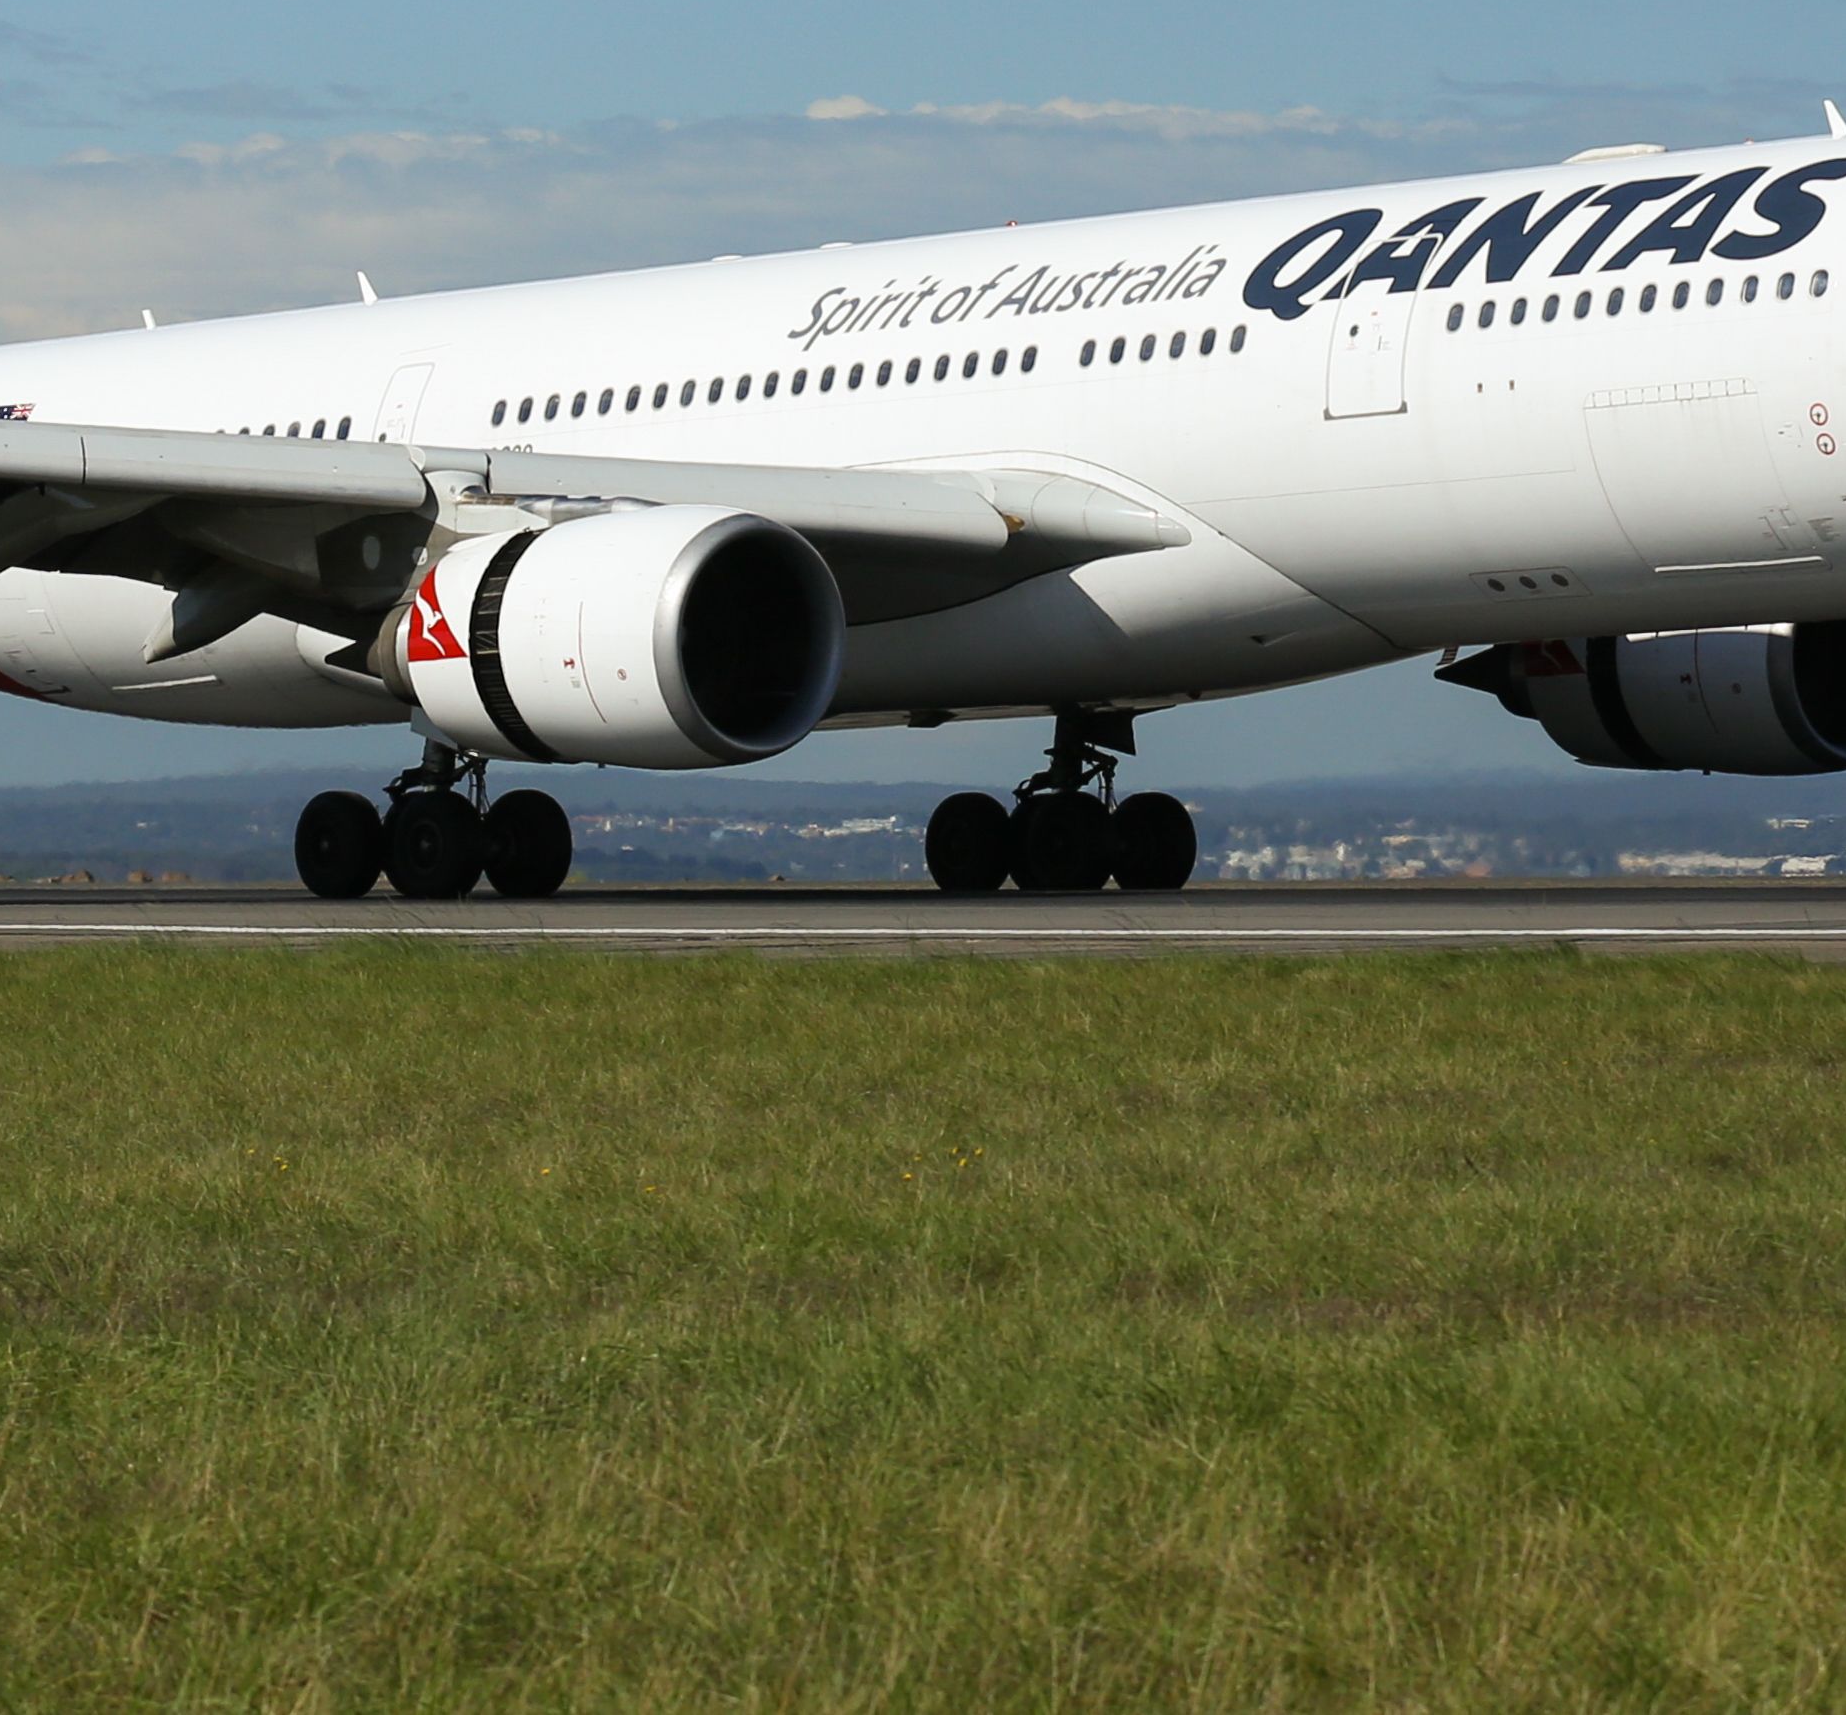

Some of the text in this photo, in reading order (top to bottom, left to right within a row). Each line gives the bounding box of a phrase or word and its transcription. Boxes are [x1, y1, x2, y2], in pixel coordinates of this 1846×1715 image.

[787, 244, 1228, 352] Spirit of Australia
